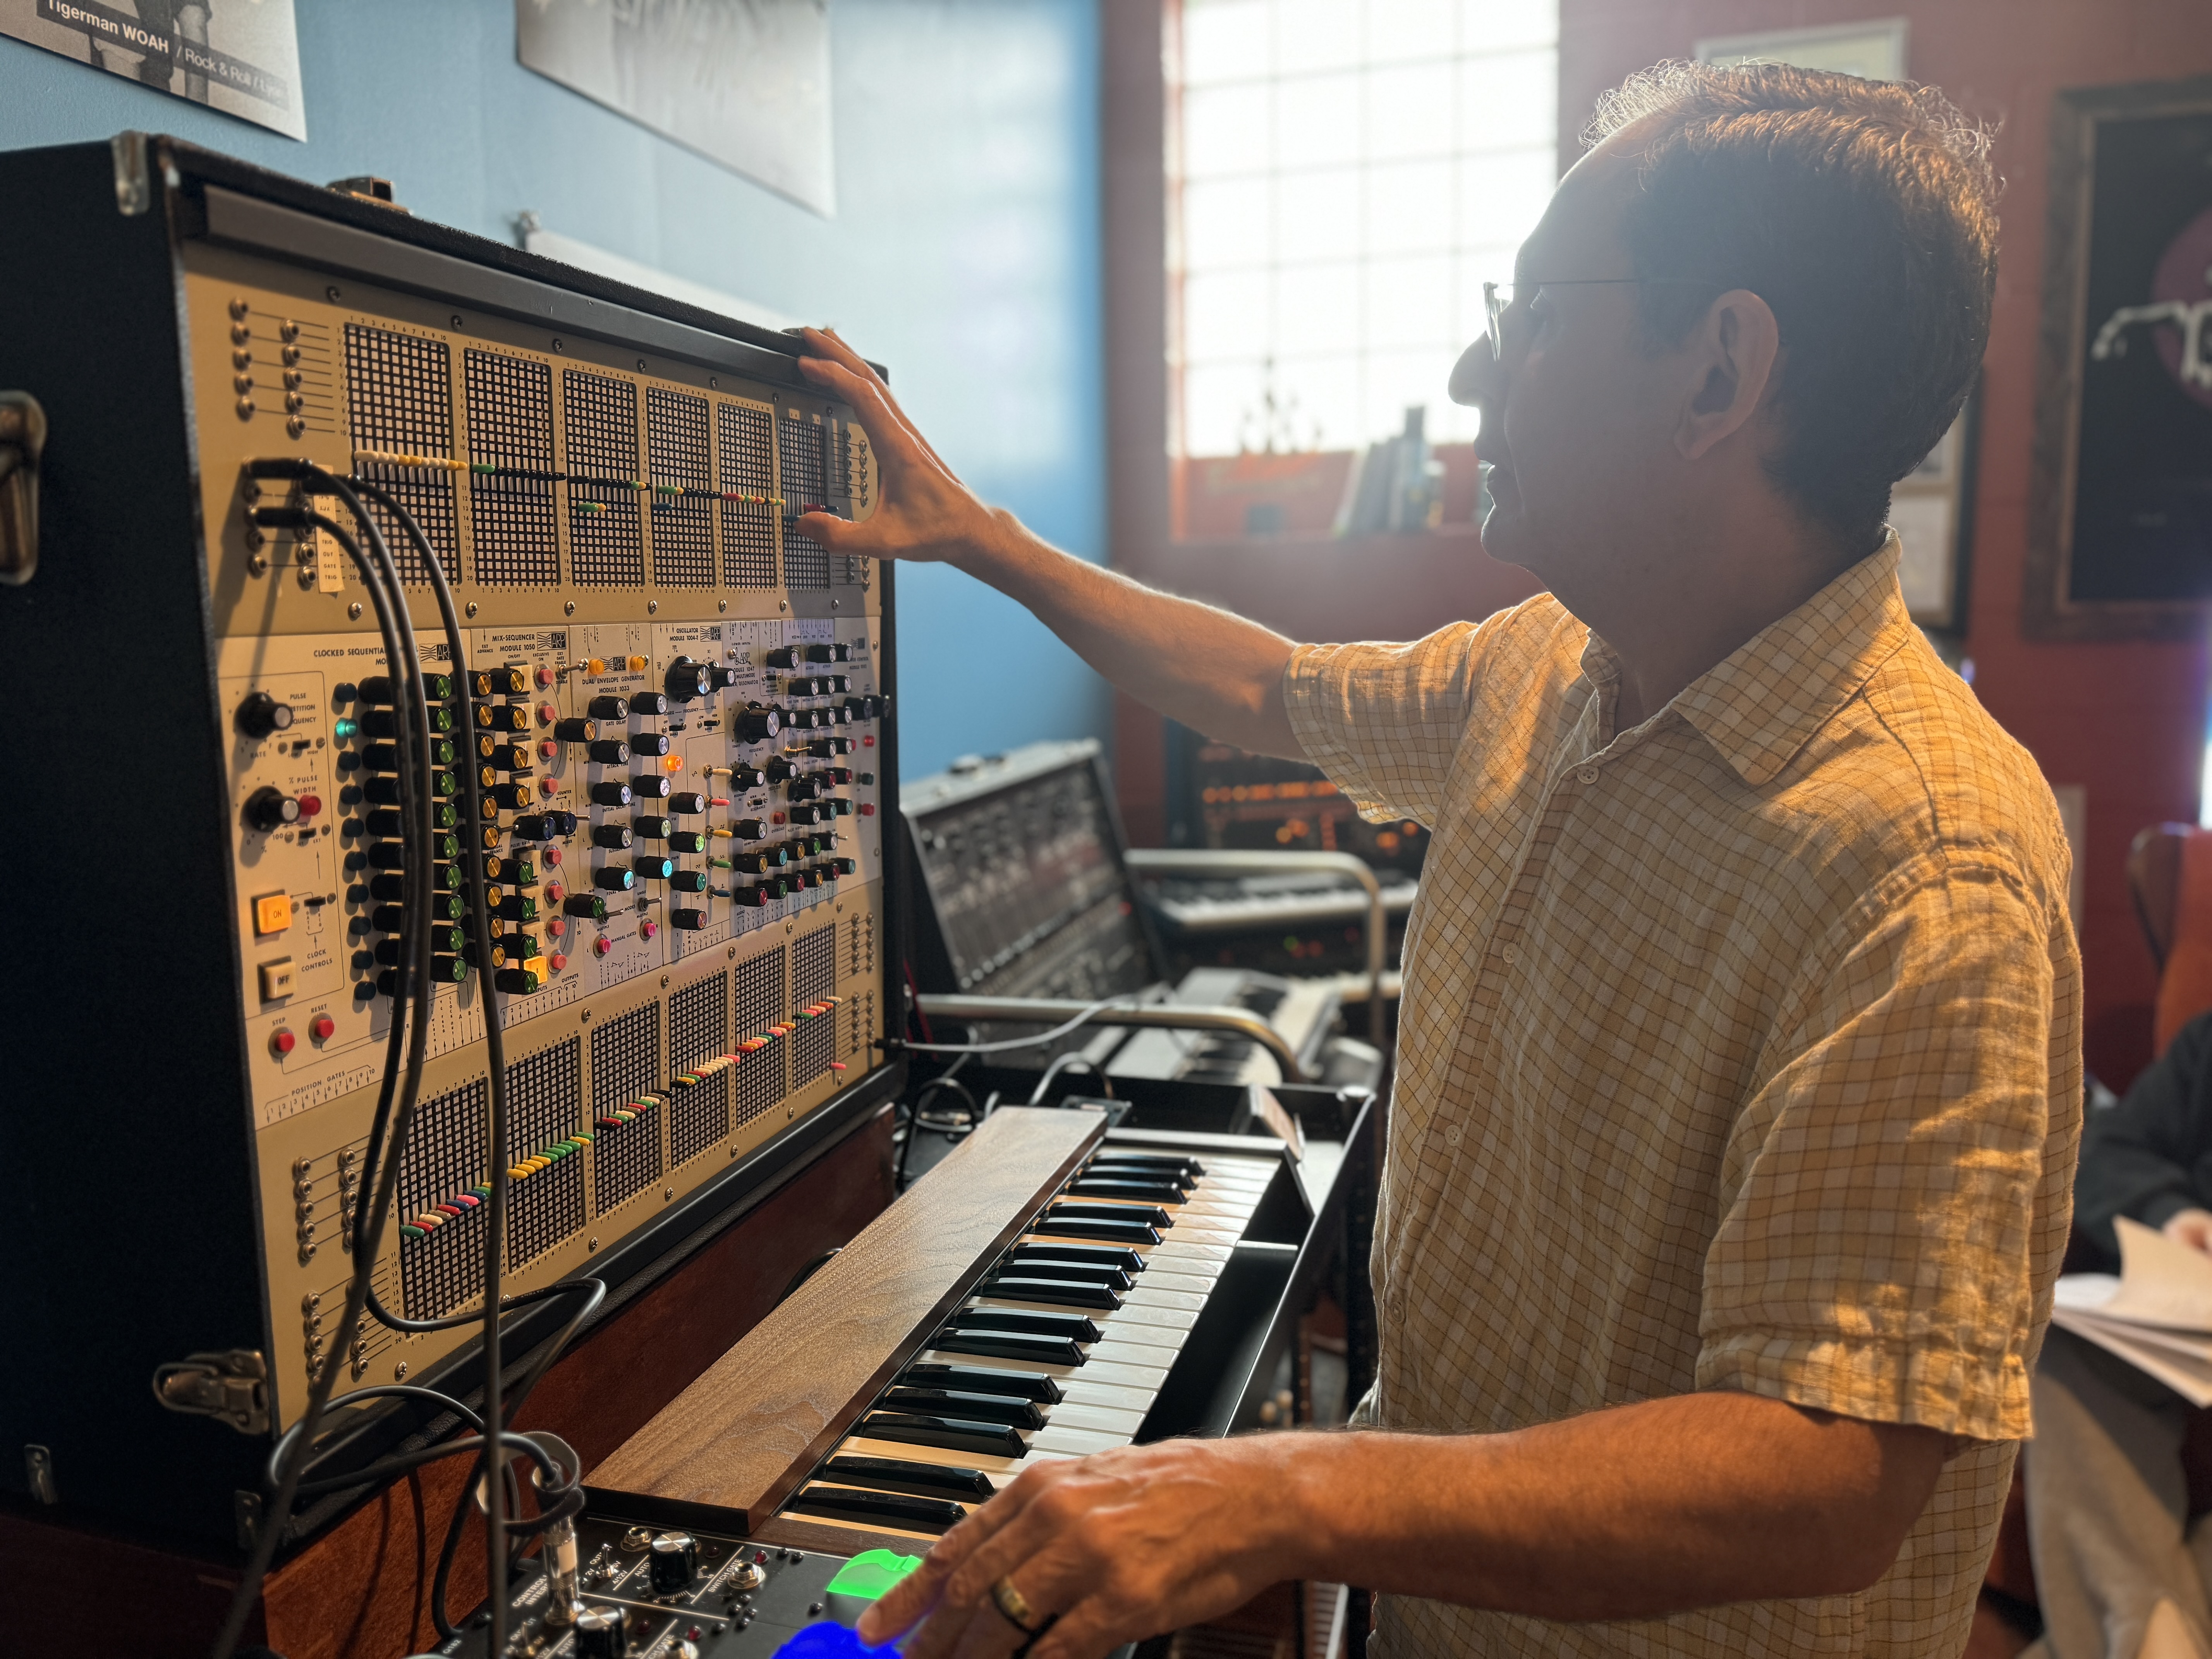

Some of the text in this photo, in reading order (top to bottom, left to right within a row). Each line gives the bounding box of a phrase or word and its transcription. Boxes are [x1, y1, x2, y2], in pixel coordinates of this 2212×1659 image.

[49, 0, 118, 34] Tigerman
[122, 23, 168, 53] WOAH
[185, 48, 216, 72] Rock
[219, 62, 228, 76] &
[710, 627, 721, 640] ARP
[551, 634, 565, 648] ARP
[314, 649, 344, 658] CLOCKED
[613, 657, 625, 671] ARP
[297, 775, 318, 783] PULSE
[294, 786, 316, 795] WIDTH
[273, 910, 282, 919] ON
[611, 935, 626, 943] MANUAL
[307, 949, 326, 959] CLOCK
[301, 958, 333, 972] CONTROLS
[278, 975, 290, 985] OFF
[562, 973, 579, 983] OUTPUTS
[311, 1003, 327, 1013] RESET
[272, 1017, 286, 1026] STEP
[292, 1071, 345, 1096] POSITION GATES
[634, 1562, 650, 1577] AUTO
[708, 1558, 742, 1592] SWITCH GATE
[612, 1570, 628, 1584] 4/12V
[512, 1575, 548, 1607] CONTROL
[443, 1639, 462, 1655] Q182
[558, 1638, 574, 1655] AUTO
